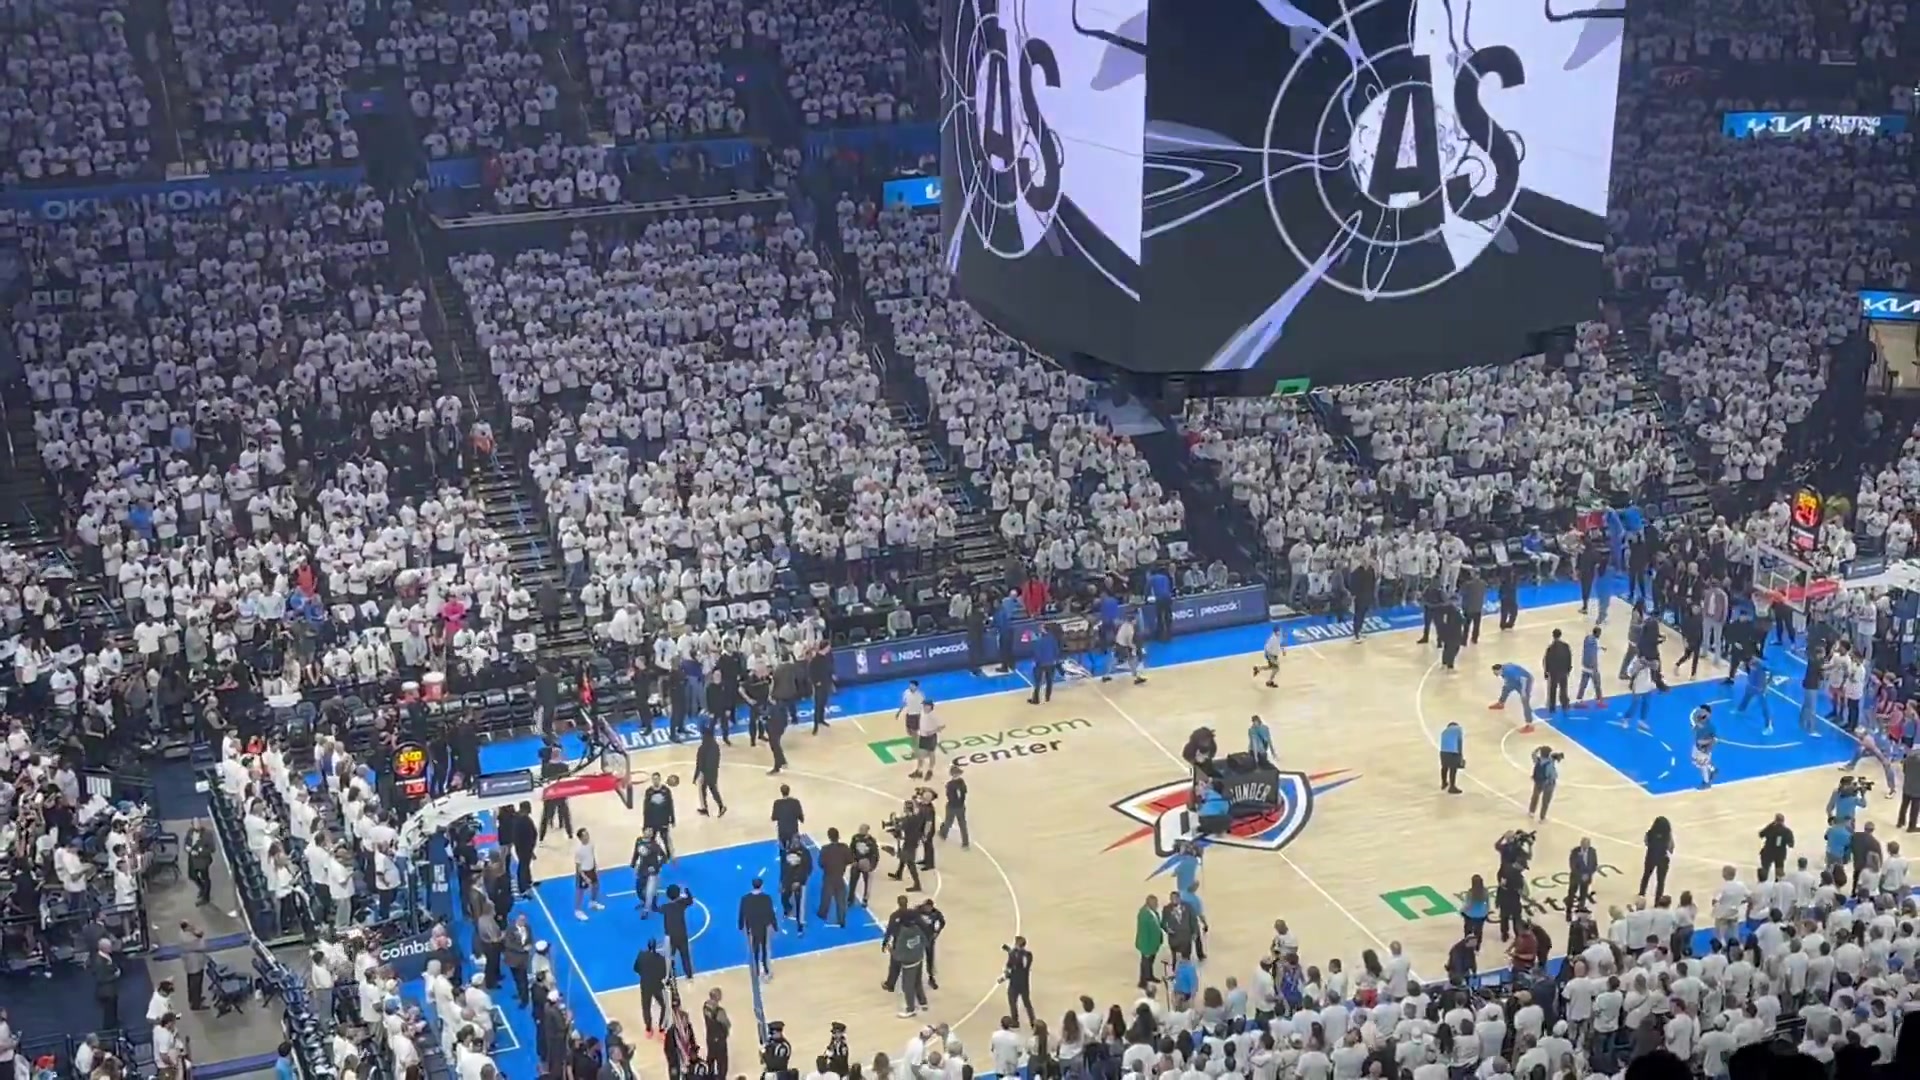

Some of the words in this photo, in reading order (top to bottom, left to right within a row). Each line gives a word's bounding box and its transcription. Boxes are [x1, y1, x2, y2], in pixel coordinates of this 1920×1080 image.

[898, 649, 923, 661] NBC
[937, 717, 1093, 754] paycom
[952, 738, 1063, 768] center
